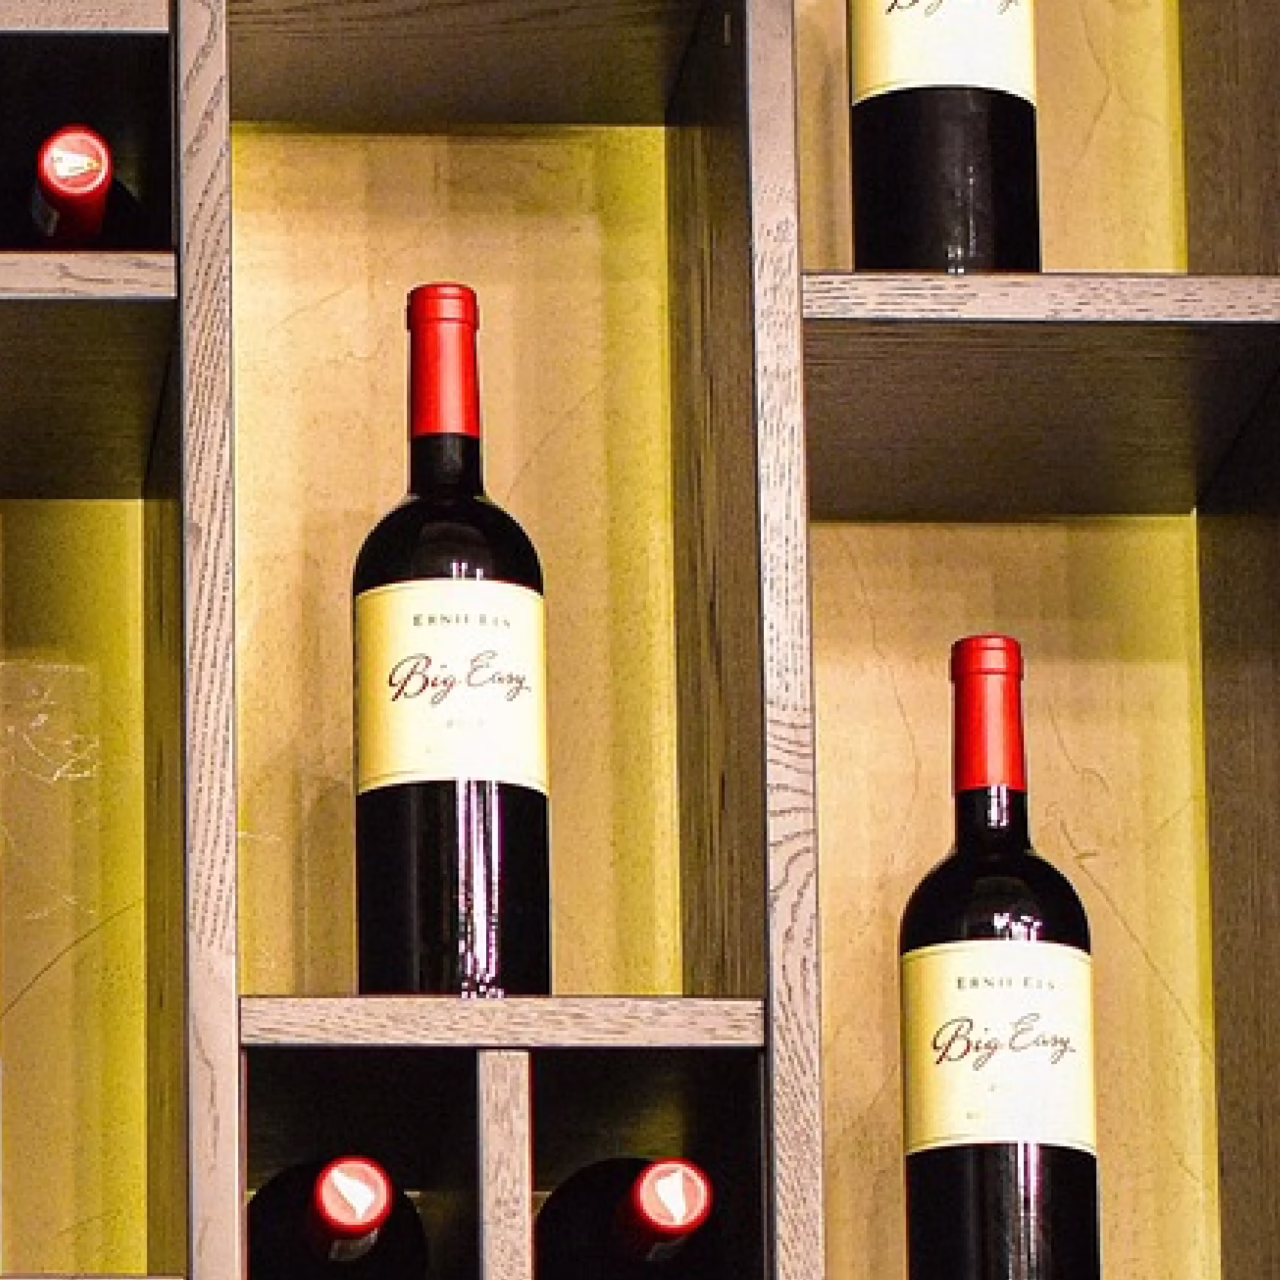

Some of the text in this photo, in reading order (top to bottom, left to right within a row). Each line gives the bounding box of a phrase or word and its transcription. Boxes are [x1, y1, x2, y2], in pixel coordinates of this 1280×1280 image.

[388, 650, 532, 708] Big Easy
[931, 1013, 1076, 1071] Big Easy
